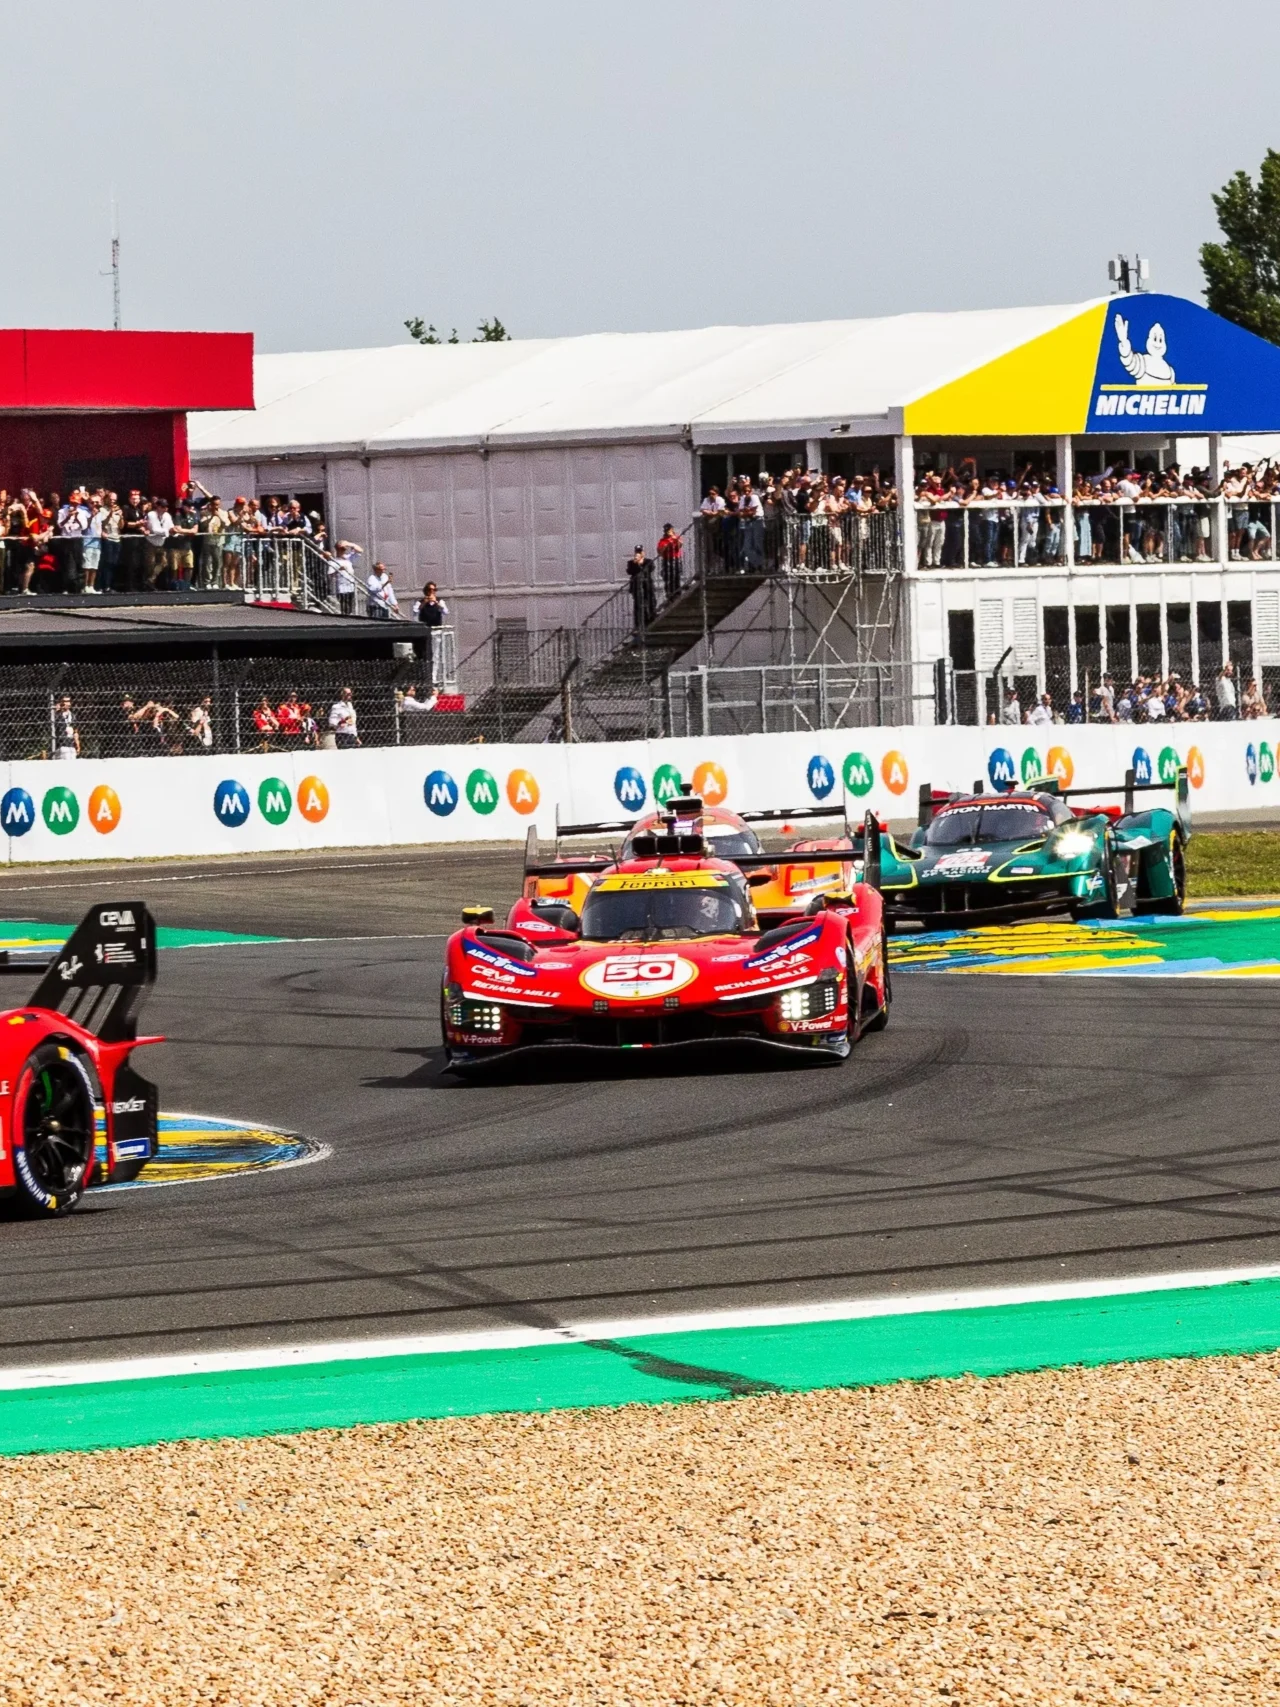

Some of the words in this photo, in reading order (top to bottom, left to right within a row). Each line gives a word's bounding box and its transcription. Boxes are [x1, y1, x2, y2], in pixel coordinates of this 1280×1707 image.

[1095, 395, 1207, 416] MICHELIN
[218, 787, 325, 817] MMA
[428, 779, 534, 807] MMA
[3, 797, 114, 827] MMA
[983, 803, 1040, 813] MARTIN
[619, 879, 697, 889] Ferrari
[604, 961, 673, 981] 50
[714, 977, 771, 992] RICHARD
[772, 965, 810, 981] MILLE
[471, 980, 523, 995] RICHARD
[523, 988, 562, 999] MILLE
[791, 1020, 833, 1032] V-Power
[462, 1034, 504, 1044] V-Power
